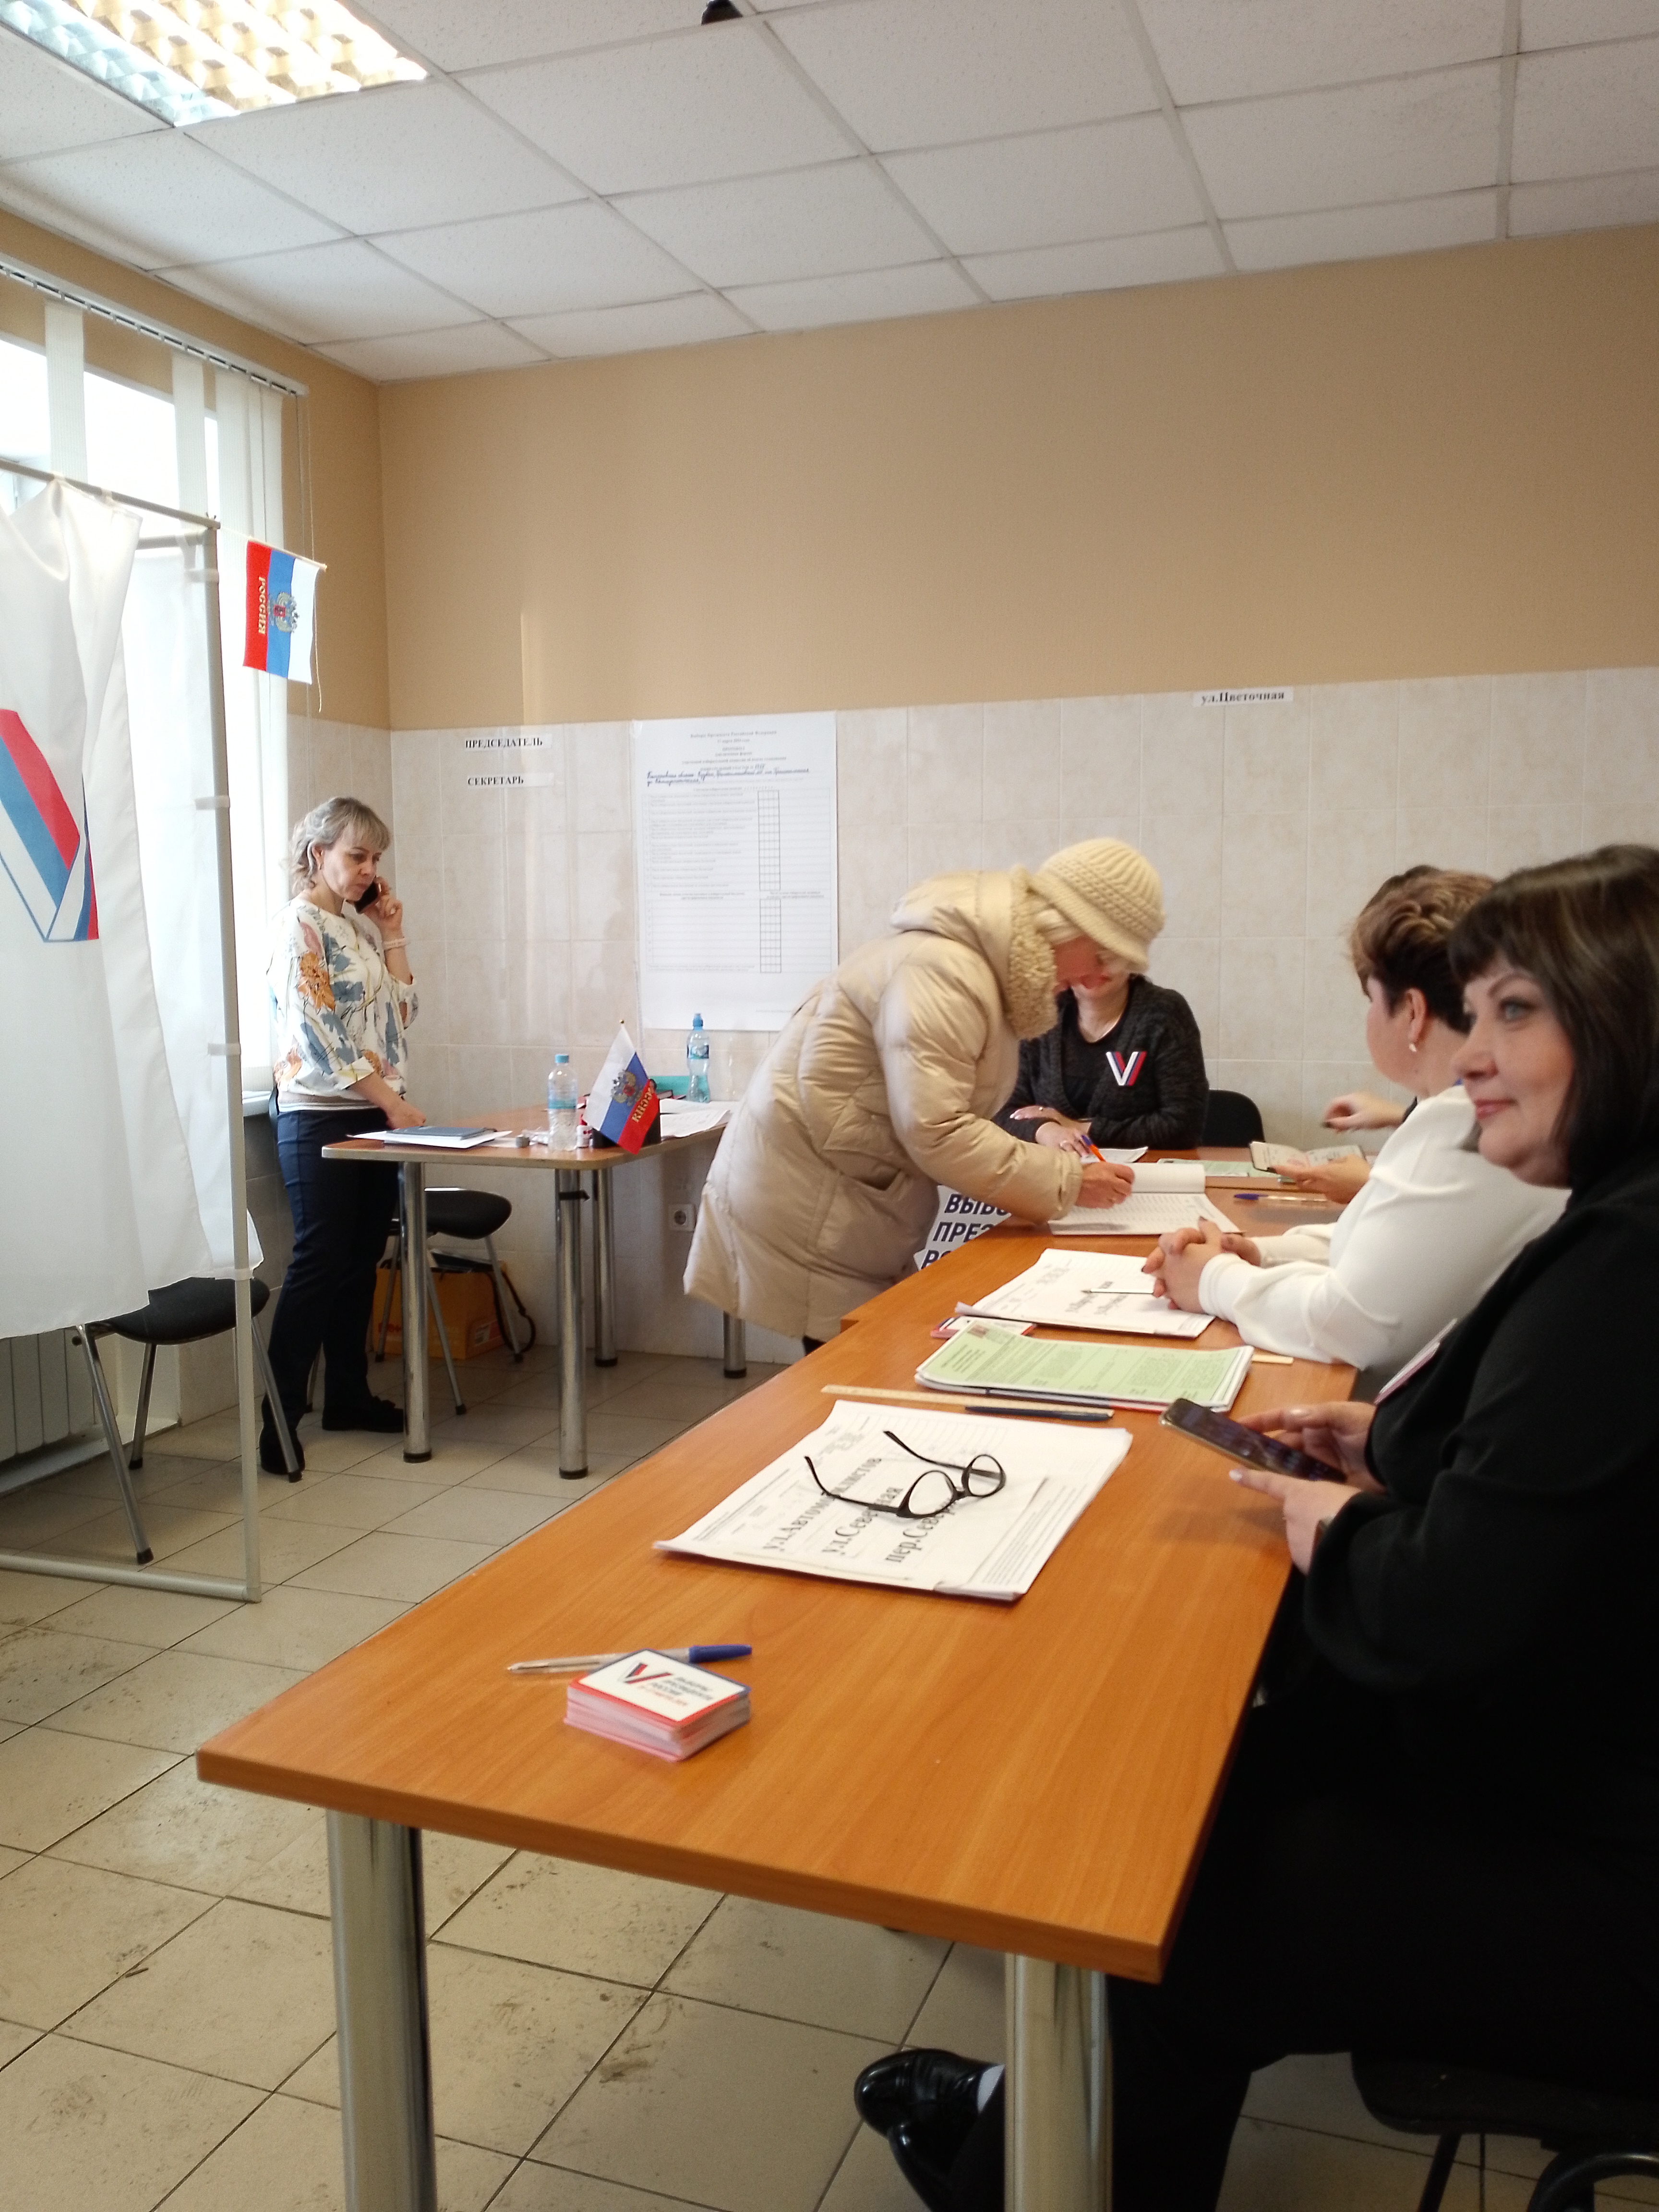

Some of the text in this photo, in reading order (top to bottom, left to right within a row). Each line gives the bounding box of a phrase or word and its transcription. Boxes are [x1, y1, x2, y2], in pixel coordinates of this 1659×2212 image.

[258, 576, 266, 635] РОССИЯ
[1202, 692, 1284, 706] ул.Цветочная
[465, 737, 543, 749] ПРЕДСЕДАТЕЛЬ
[468, 776, 524, 786] СЕКРЕТАРЬ
[920, 1250, 953, 1270] Р
[821, 1487, 903, 1555] ул.Севеная
